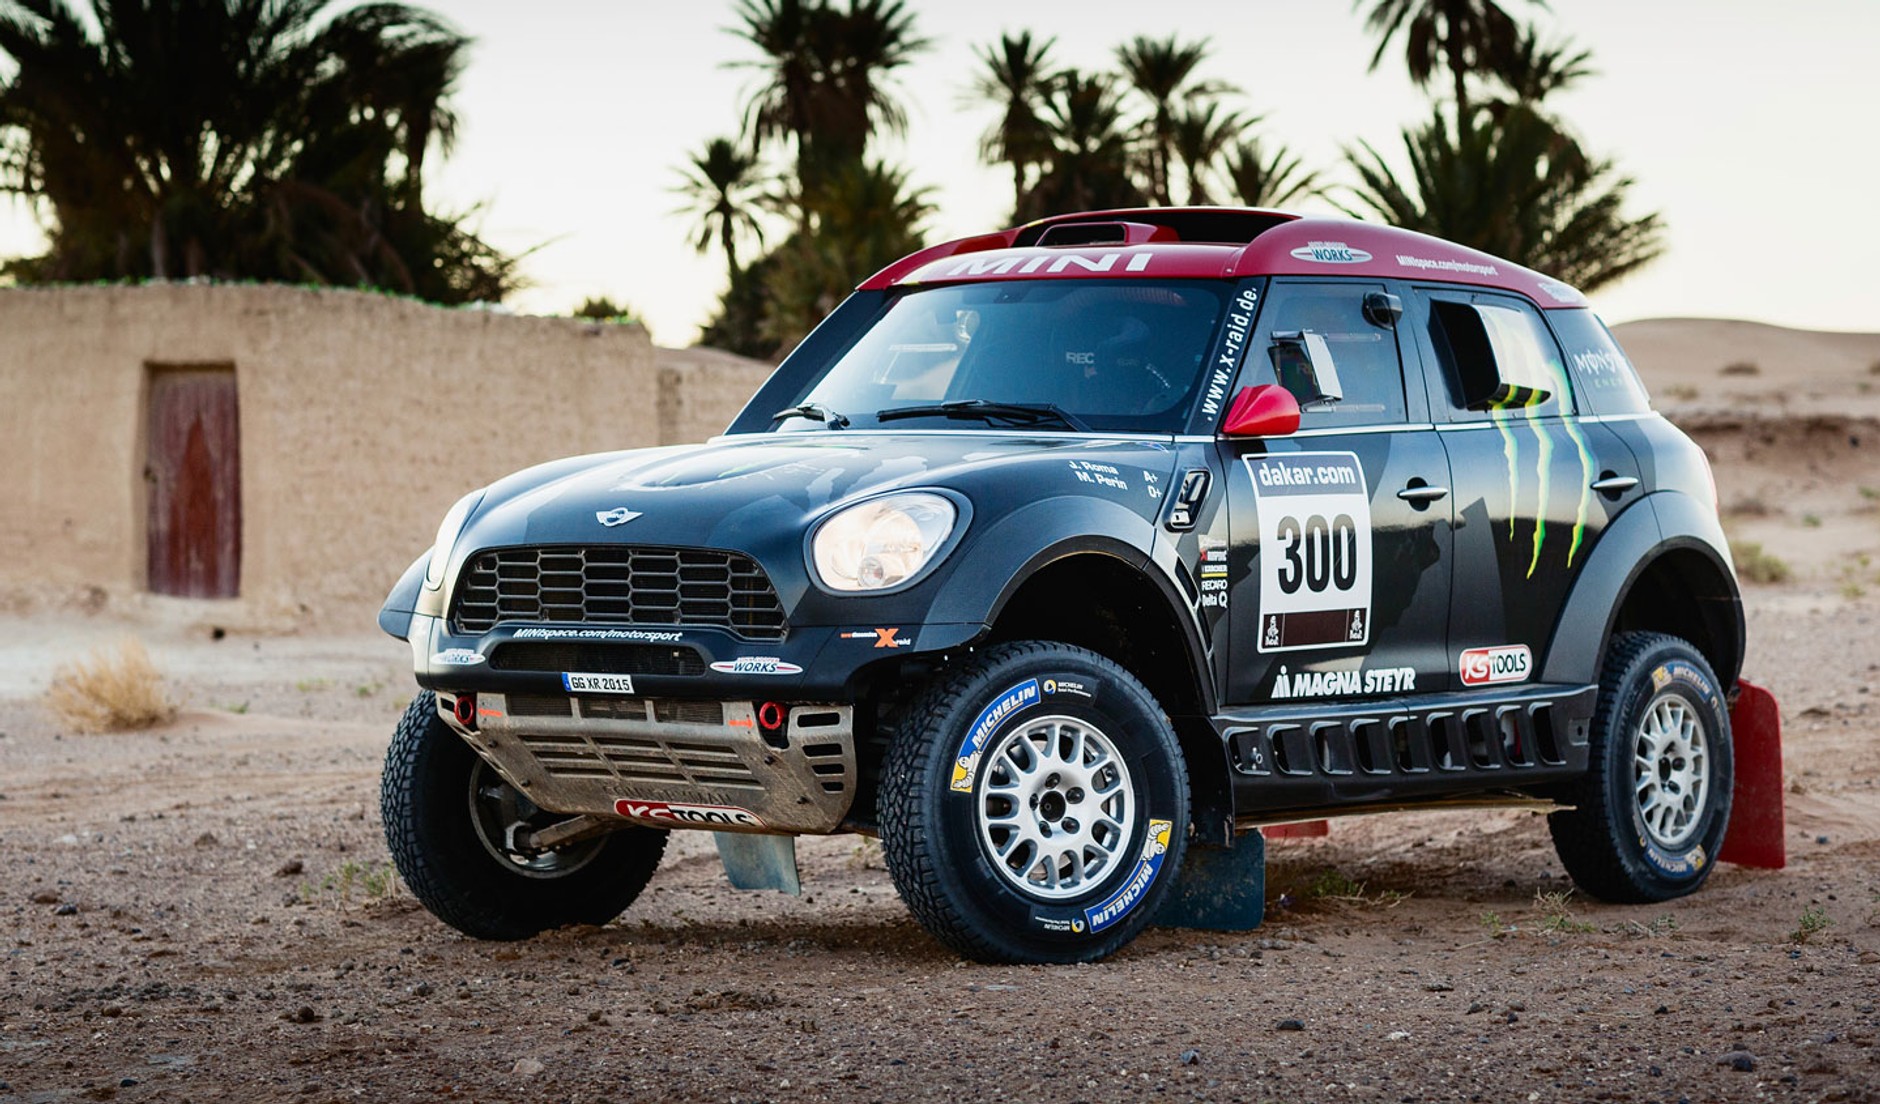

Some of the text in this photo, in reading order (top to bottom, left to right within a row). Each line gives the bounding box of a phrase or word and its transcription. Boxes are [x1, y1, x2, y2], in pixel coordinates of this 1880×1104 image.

[947, 253, 1153, 276] MINI
[1312, 248, 1353, 261] WORKS
[1069, 461, 1119, 475] J. Roma
[1143, 471, 1158, 484] A+
[1259, 462, 1355, 487] dakar.com
[1075, 471, 1128, 490] M. Perin
[1277, 514, 1357, 594] 300
[1201, 579, 1228, 591] RECARO
[513, 628, 683, 643] MINIspace.com/motorsport
[734, 662, 777, 672] WORKS
[1491, 653, 1526, 675] TOOLS
[571, 677, 630, 691] GG XR 2015
[1293, 667, 1416, 697] MAGNA STEYR
[1674, 665, 1711, 695] MICHELIN
[971, 685, 1037, 749] MICHELIN
[1647, 847, 1687, 874] MICHELIN
[1092, 864, 1154, 927] MICHELIN
